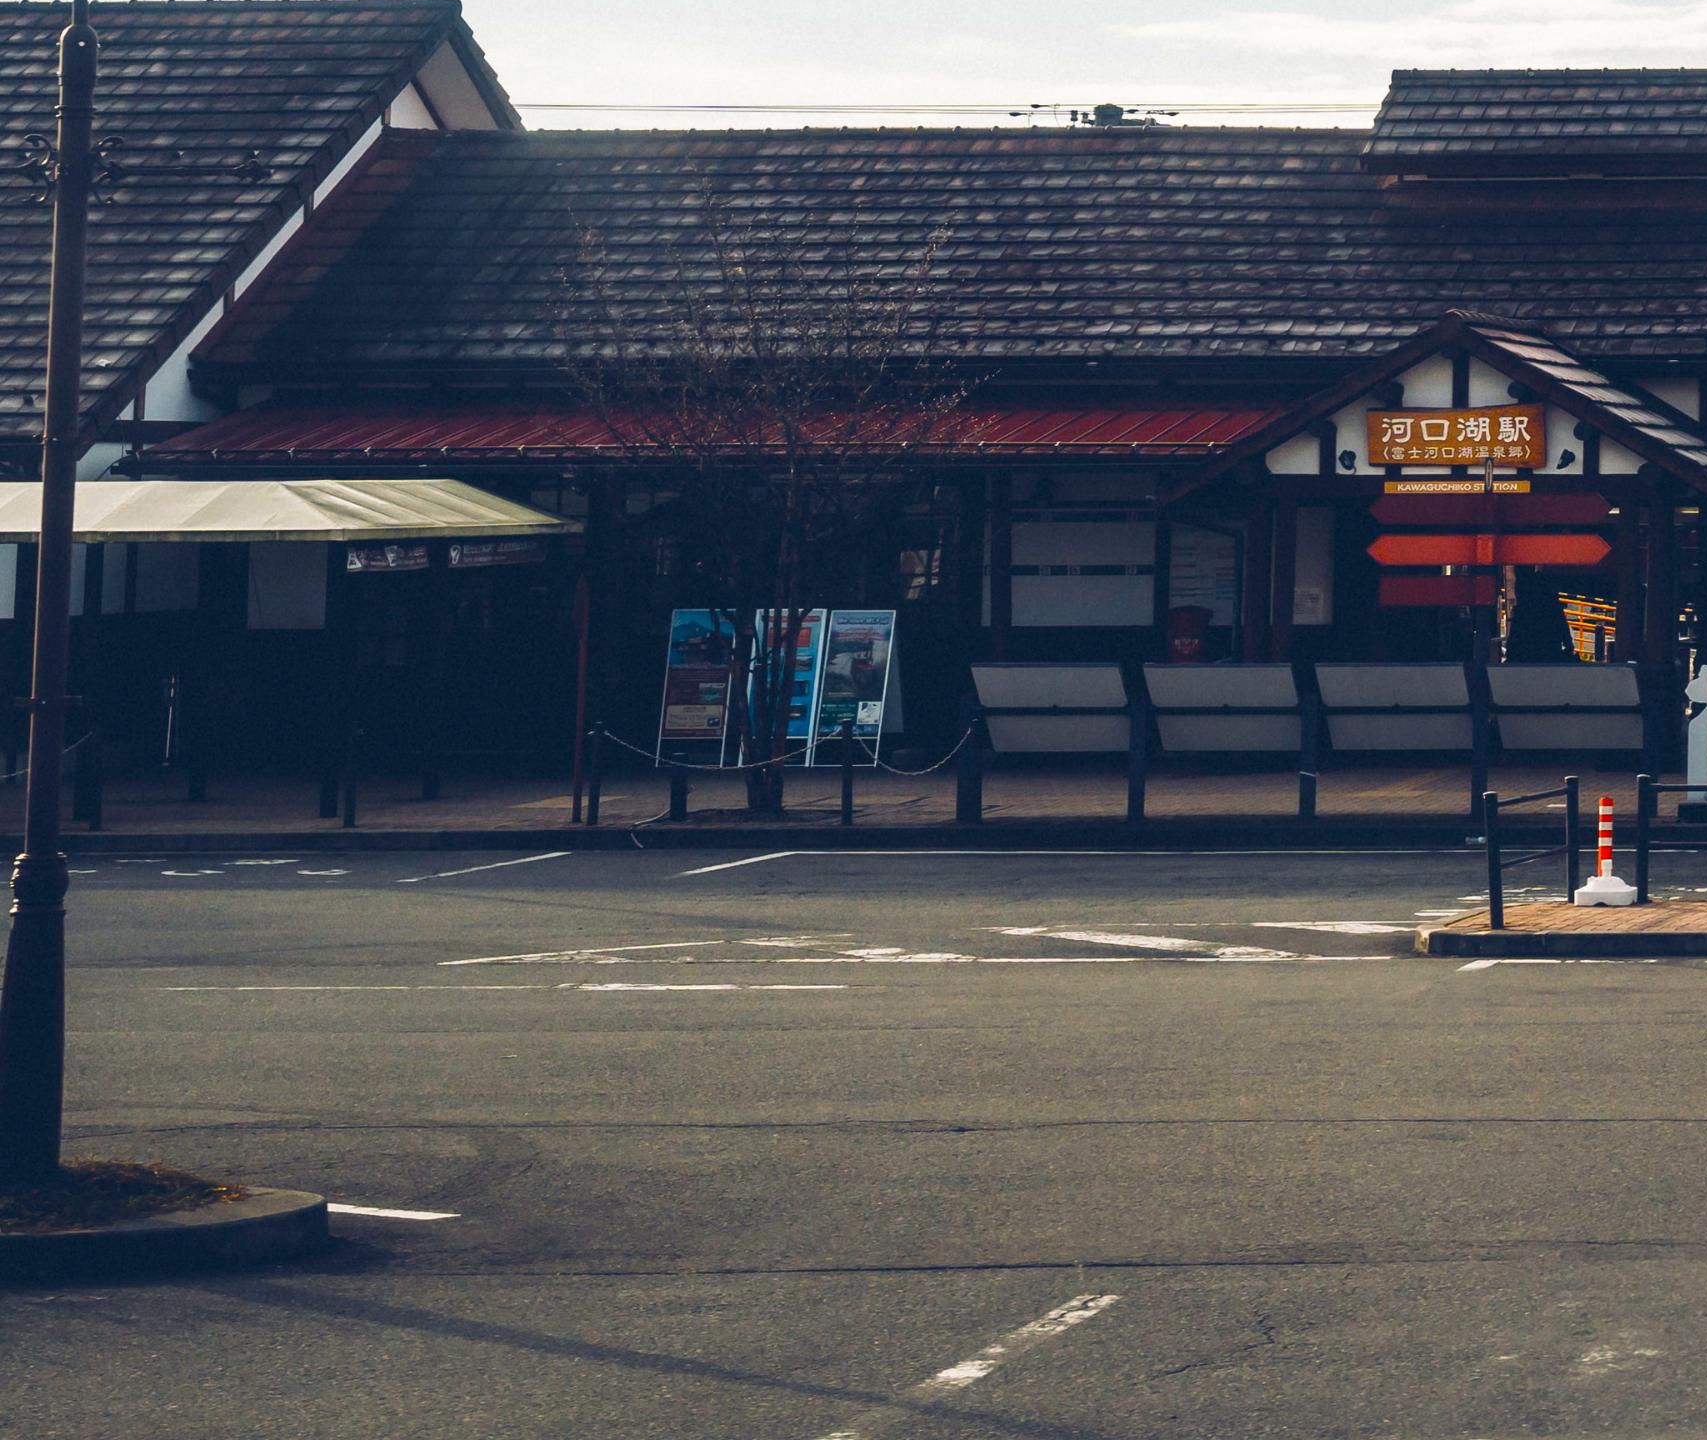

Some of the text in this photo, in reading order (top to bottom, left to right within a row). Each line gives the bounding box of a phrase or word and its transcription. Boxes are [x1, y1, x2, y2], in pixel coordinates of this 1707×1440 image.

[1381, 416, 1532, 443] 河口湖駅
[1397, 483, 1518, 492] KAWAGUCHIKO STTION
